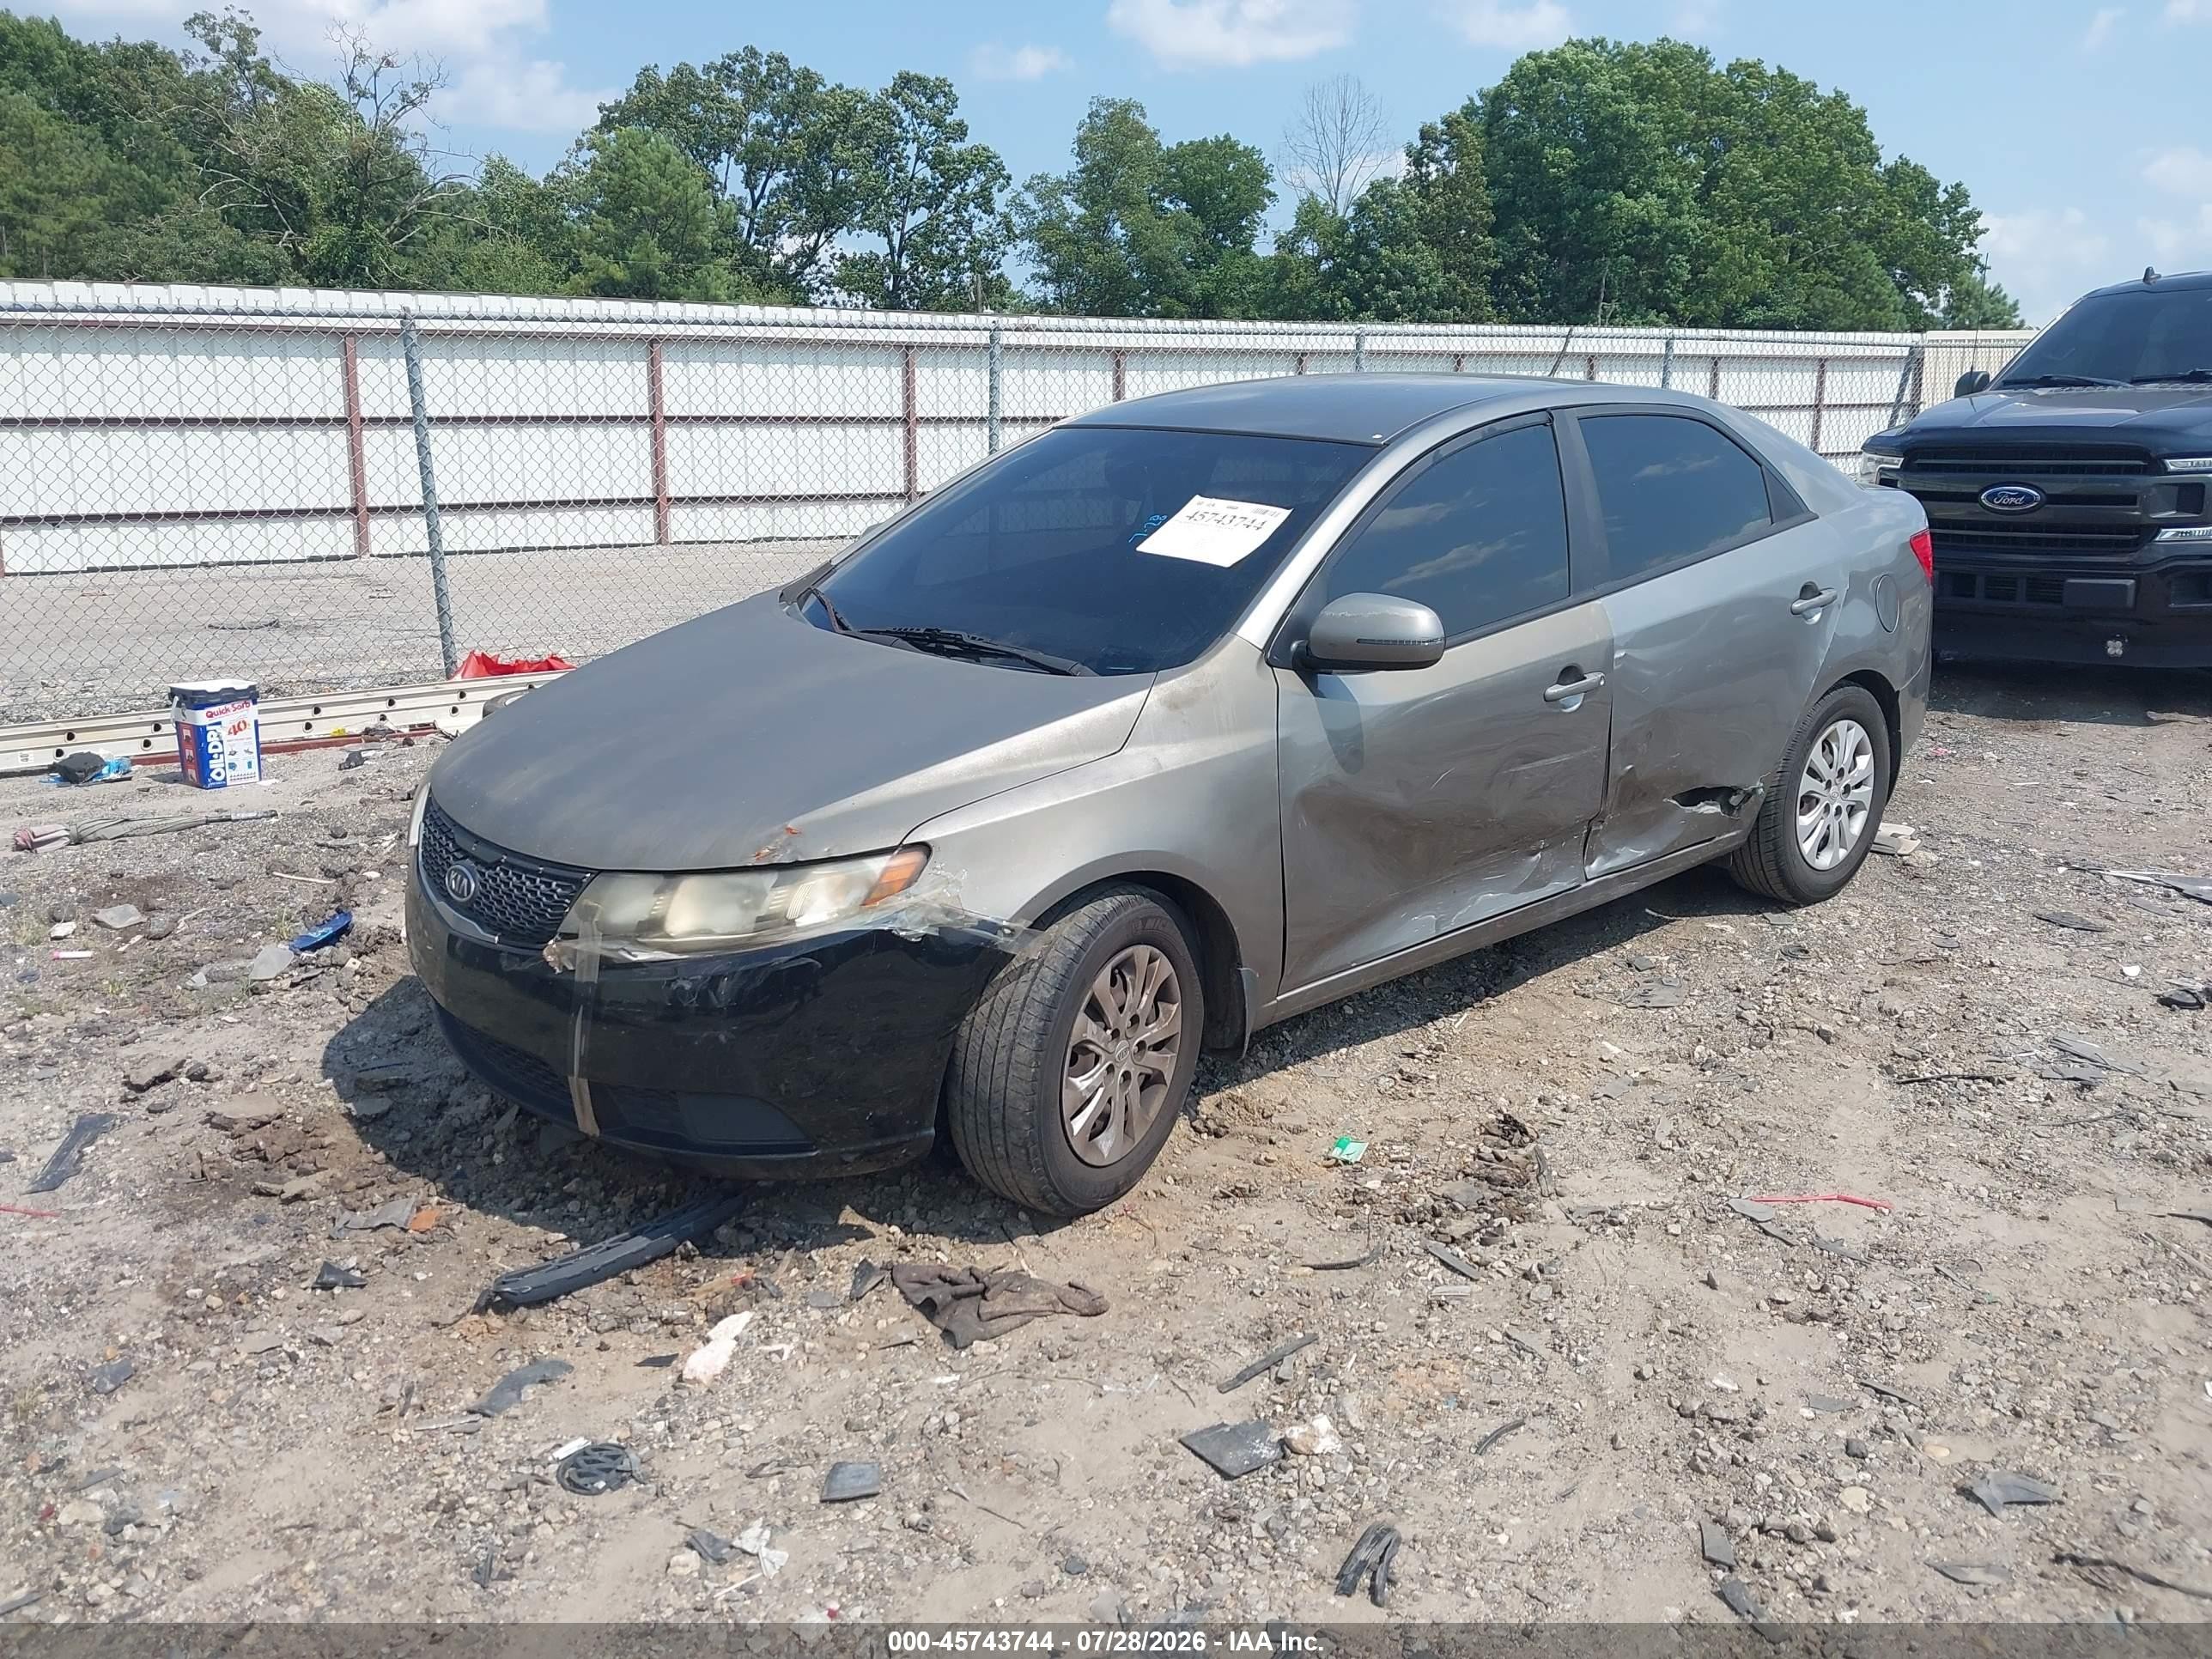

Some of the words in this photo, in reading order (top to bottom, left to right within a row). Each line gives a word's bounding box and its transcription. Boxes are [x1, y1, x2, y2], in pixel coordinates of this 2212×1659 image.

[1993, 490, 2027, 505] Ford
[1185, 511, 1267, 530] 45743744
[205, 705, 231, 719] Quick
[231, 700, 251, 712] Sorb
[449, 870, 468, 897] KIA
